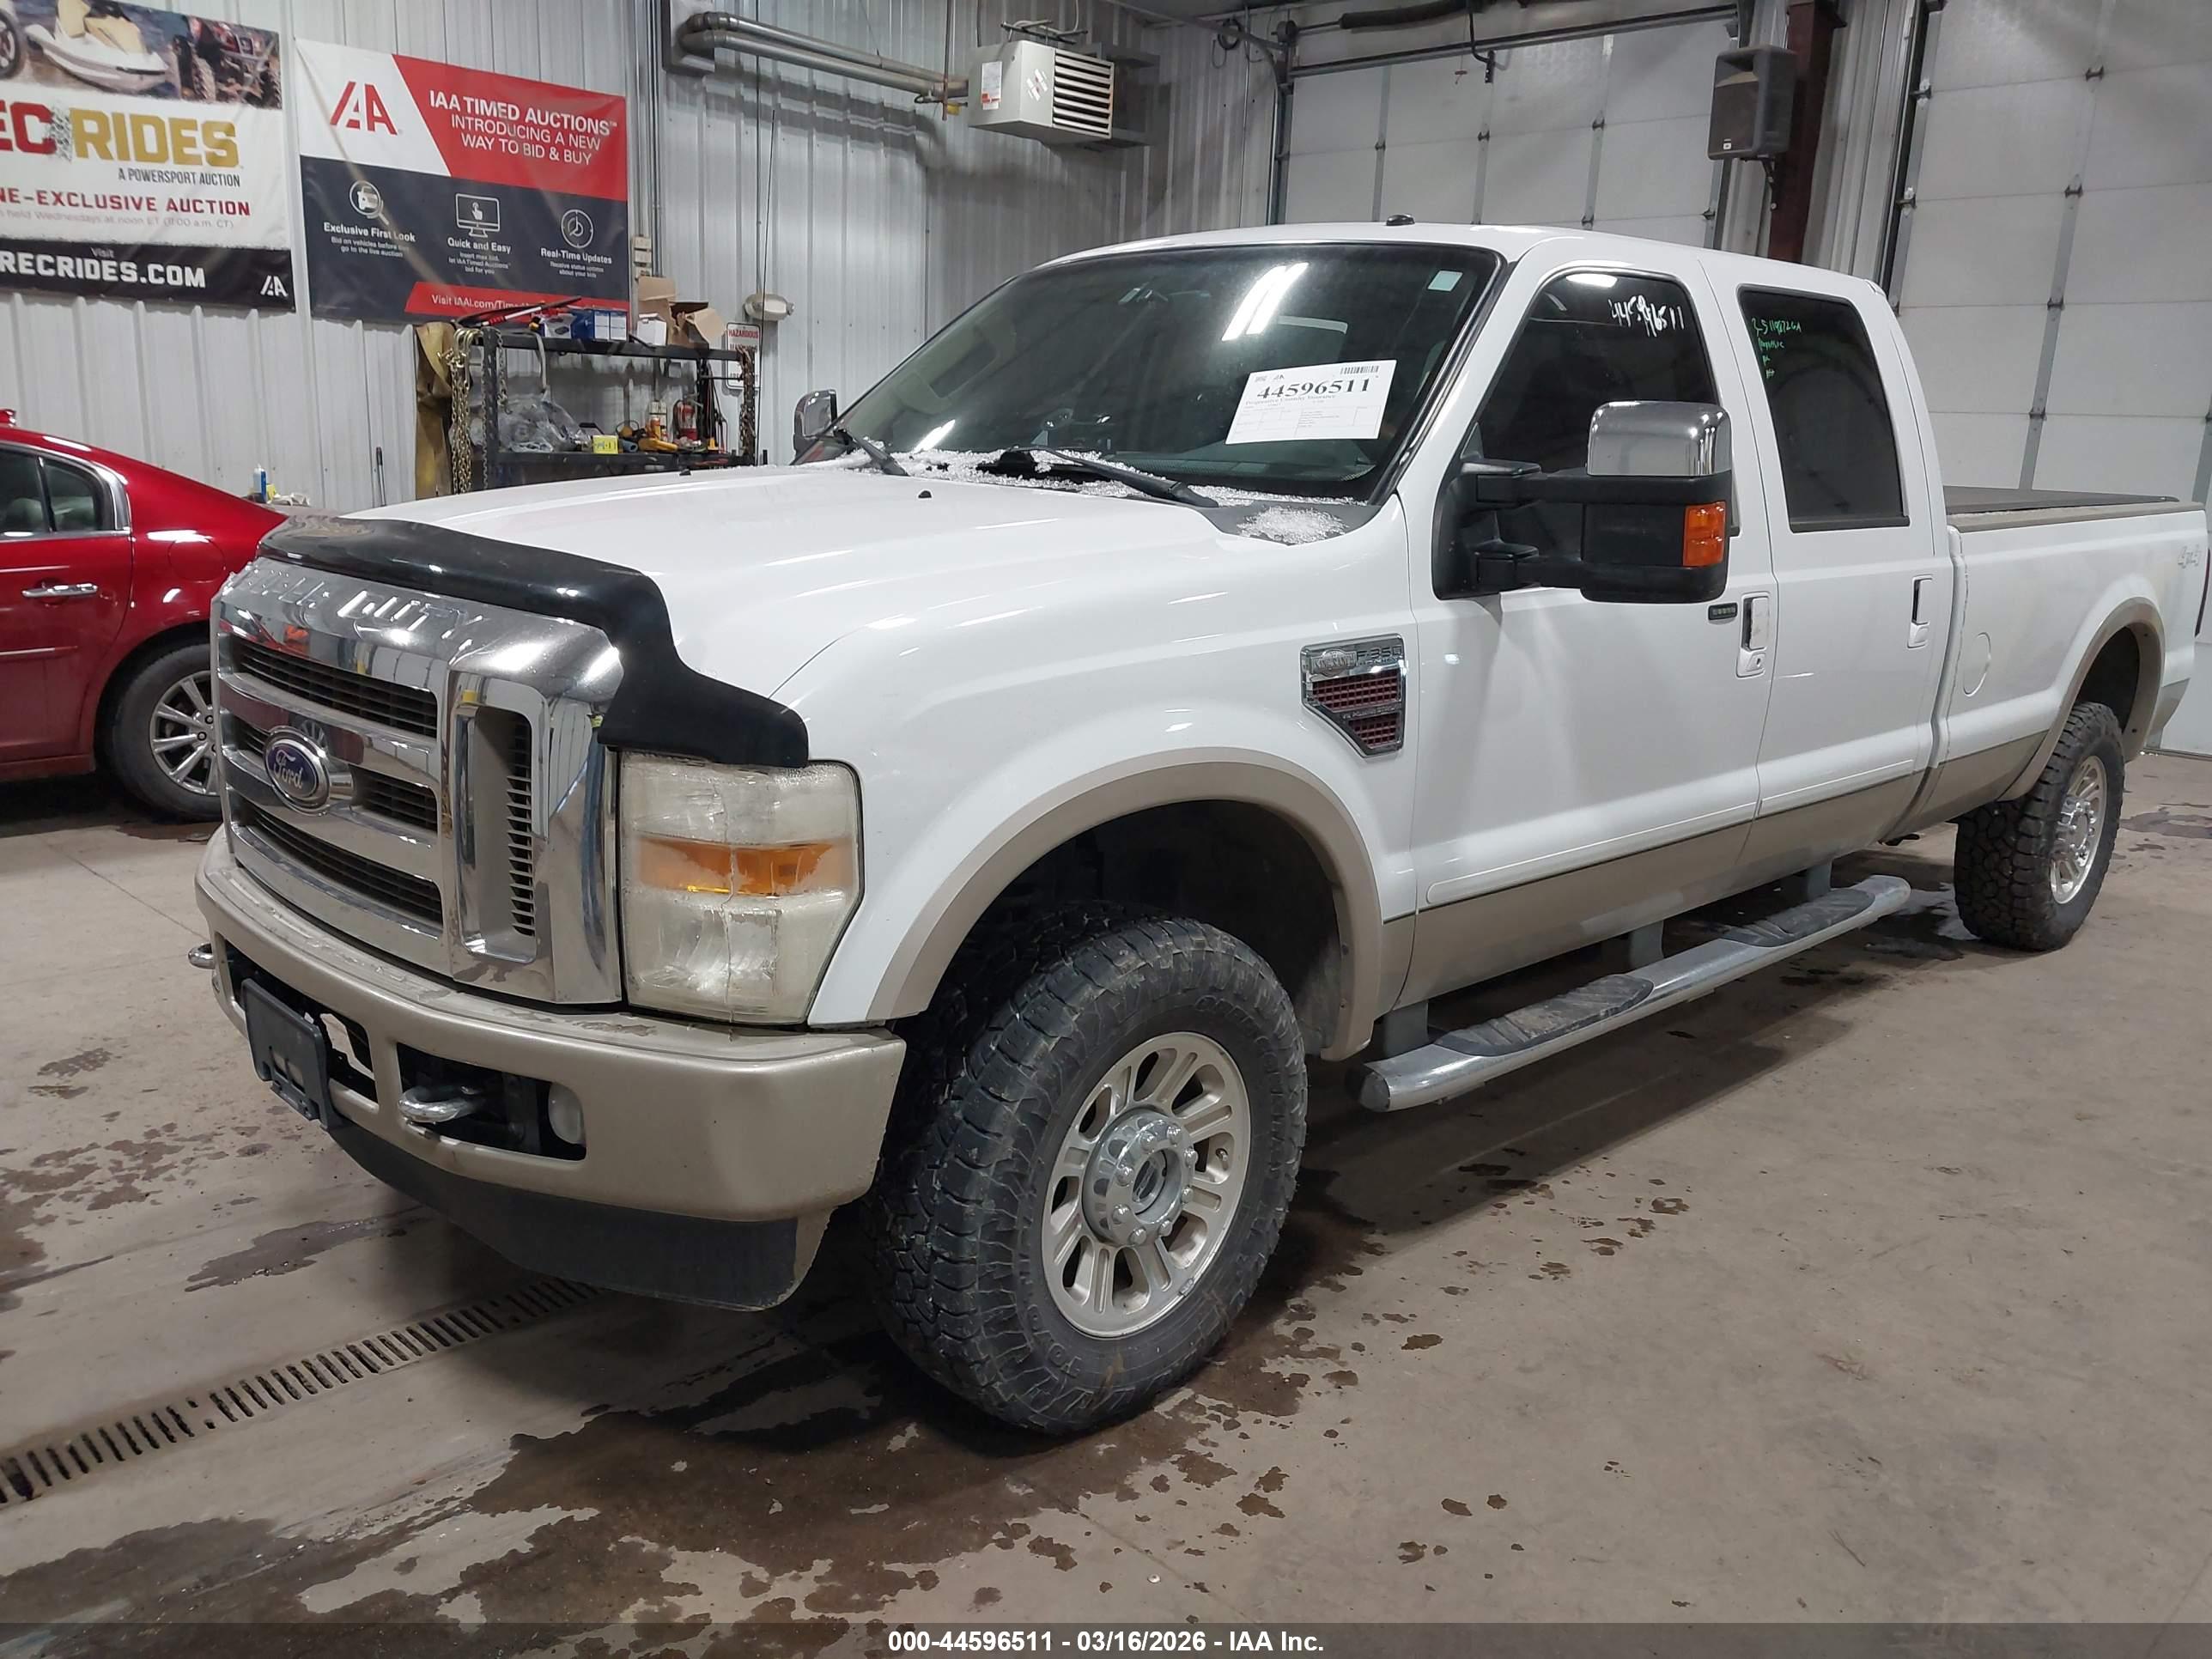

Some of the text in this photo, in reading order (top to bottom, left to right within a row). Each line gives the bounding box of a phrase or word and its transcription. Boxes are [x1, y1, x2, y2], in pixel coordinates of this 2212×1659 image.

[429, 89, 461, 112] IAA
[463, 96, 520, 121] TIMED
[69, 107, 240, 168] RIDES
[451, 113, 601, 151] INTRODUCING A NEW
[461, 133, 592, 166] WAY TO BID & BUY
[118, 167, 241, 188] A POWERSPORT AUCTION
[166, 198, 252, 216] AUCTION
[324, 222, 369, 236] Exclusive
[371, 227, 392, 240] First
[90, 247, 114, 259] Visit
[447, 236, 512, 255] Quick and Easy
[540, 247, 612, 264] Real-Time Updates
[0, 250, 206, 289] RECRIDES.COM
[431, 294, 453, 306] Visit
[1256, 378, 1370, 399] 44596511
[273, 749, 303, 789] Ford
